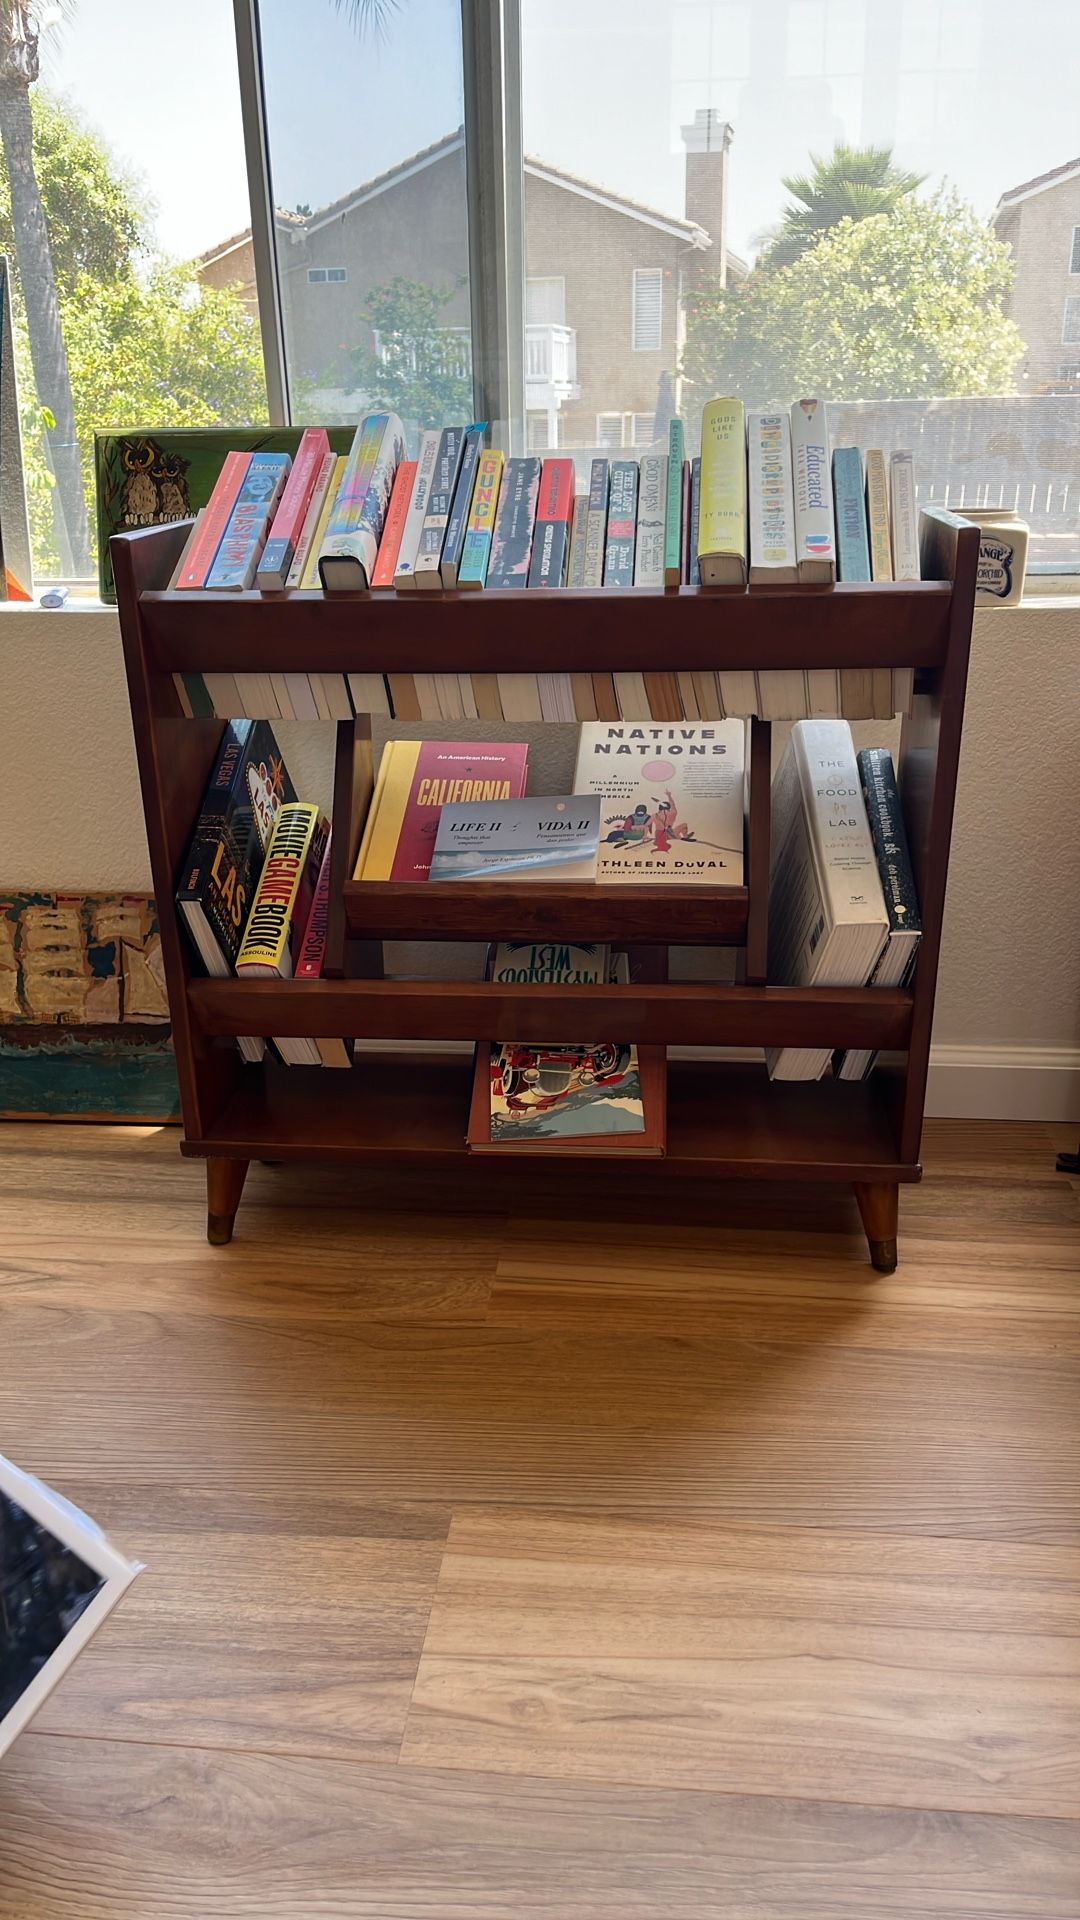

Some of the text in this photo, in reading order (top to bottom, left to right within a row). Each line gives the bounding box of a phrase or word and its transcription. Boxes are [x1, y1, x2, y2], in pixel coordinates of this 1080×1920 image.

[711, 416, 737, 425] GODS
[712, 424, 734, 433] LIKE
[321, 456, 332, 472] PEDRO
[870, 456, 881, 470] GOOD
[513, 472, 524, 501] JANE EYRE
[612, 470, 623, 490] CITY
[623, 470, 634, 488] THE
[640, 459, 660, 512] GOOD OMENS
[796, 443, 806, 512] TARA WESTOVER
[805, 445, 828, 509] Educated
[412, 477, 429, 510] HOLLYWOOD
[470, 459, 497, 548] GUNCLE
[612, 492, 622, 503] OF
[622, 490, 633, 512] LOST
[842, 498, 860, 538] FICTION
[587, 519, 599, 549] SCANNER
[640, 534, 650, 547] Terry
[540, 524, 554, 575] CINEMA SPECULATION
[605, 545, 617, 570] Grann
[618, 545, 629, 569] David
[585, 552, 598, 577] DARKLY
[978, 569, 1004, 580] ORCHID
[607, 728, 715, 739] NATIVE
[594, 744, 727, 755] NATIONS
[215, 743, 241, 786] LAS VEGAS
[818, 760, 846, 769] THE
[416, 778, 511, 806] CALIFORNIA
[817, 789, 857, 797] FOOD
[869, 750, 894, 837] smitten kitchen cookbook
[254, 788, 270, 829] LAS
[450, 823, 502, 832] LIFE II
[537, 820, 590, 831] VIDA II
[829, 819, 857, 827] LAB
[601, 860, 667, 868] THLEEN
[887, 864, 898, 875] deb
[186, 868, 200, 890] BULFINCH
[211, 842, 247, 926] LAS
[888, 875, 901, 902] perelman
[240, 949, 277, 960] ASSOULINE
[528, 946, 571, 970] WEST
